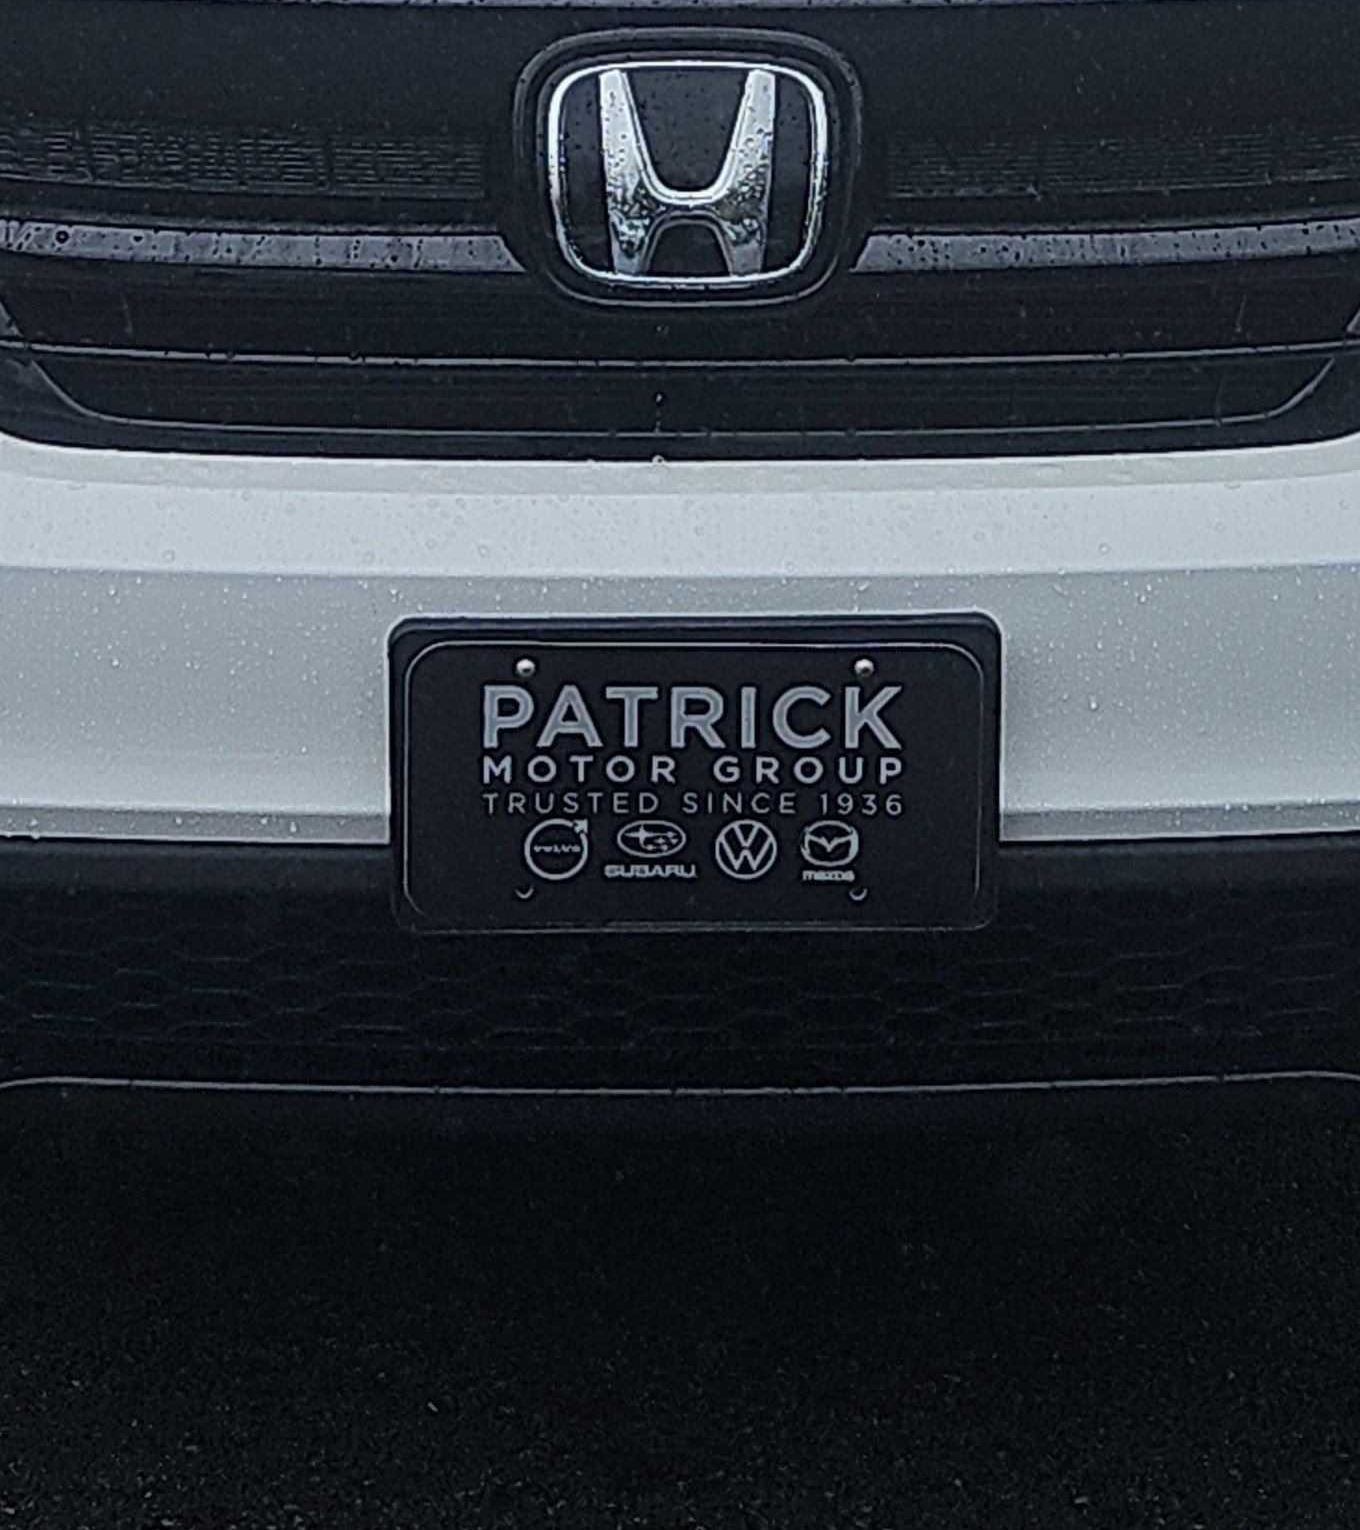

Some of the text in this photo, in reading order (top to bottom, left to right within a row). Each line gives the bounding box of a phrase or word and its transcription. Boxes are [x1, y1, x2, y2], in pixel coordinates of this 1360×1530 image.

[483, 685, 903, 750] PATRICK
[483, 755, 903, 785] MOTOR GROUP
[482, 792, 903, 816] TRUSTED SINCE 1936
[604, 864, 697, 879] SUBARU
